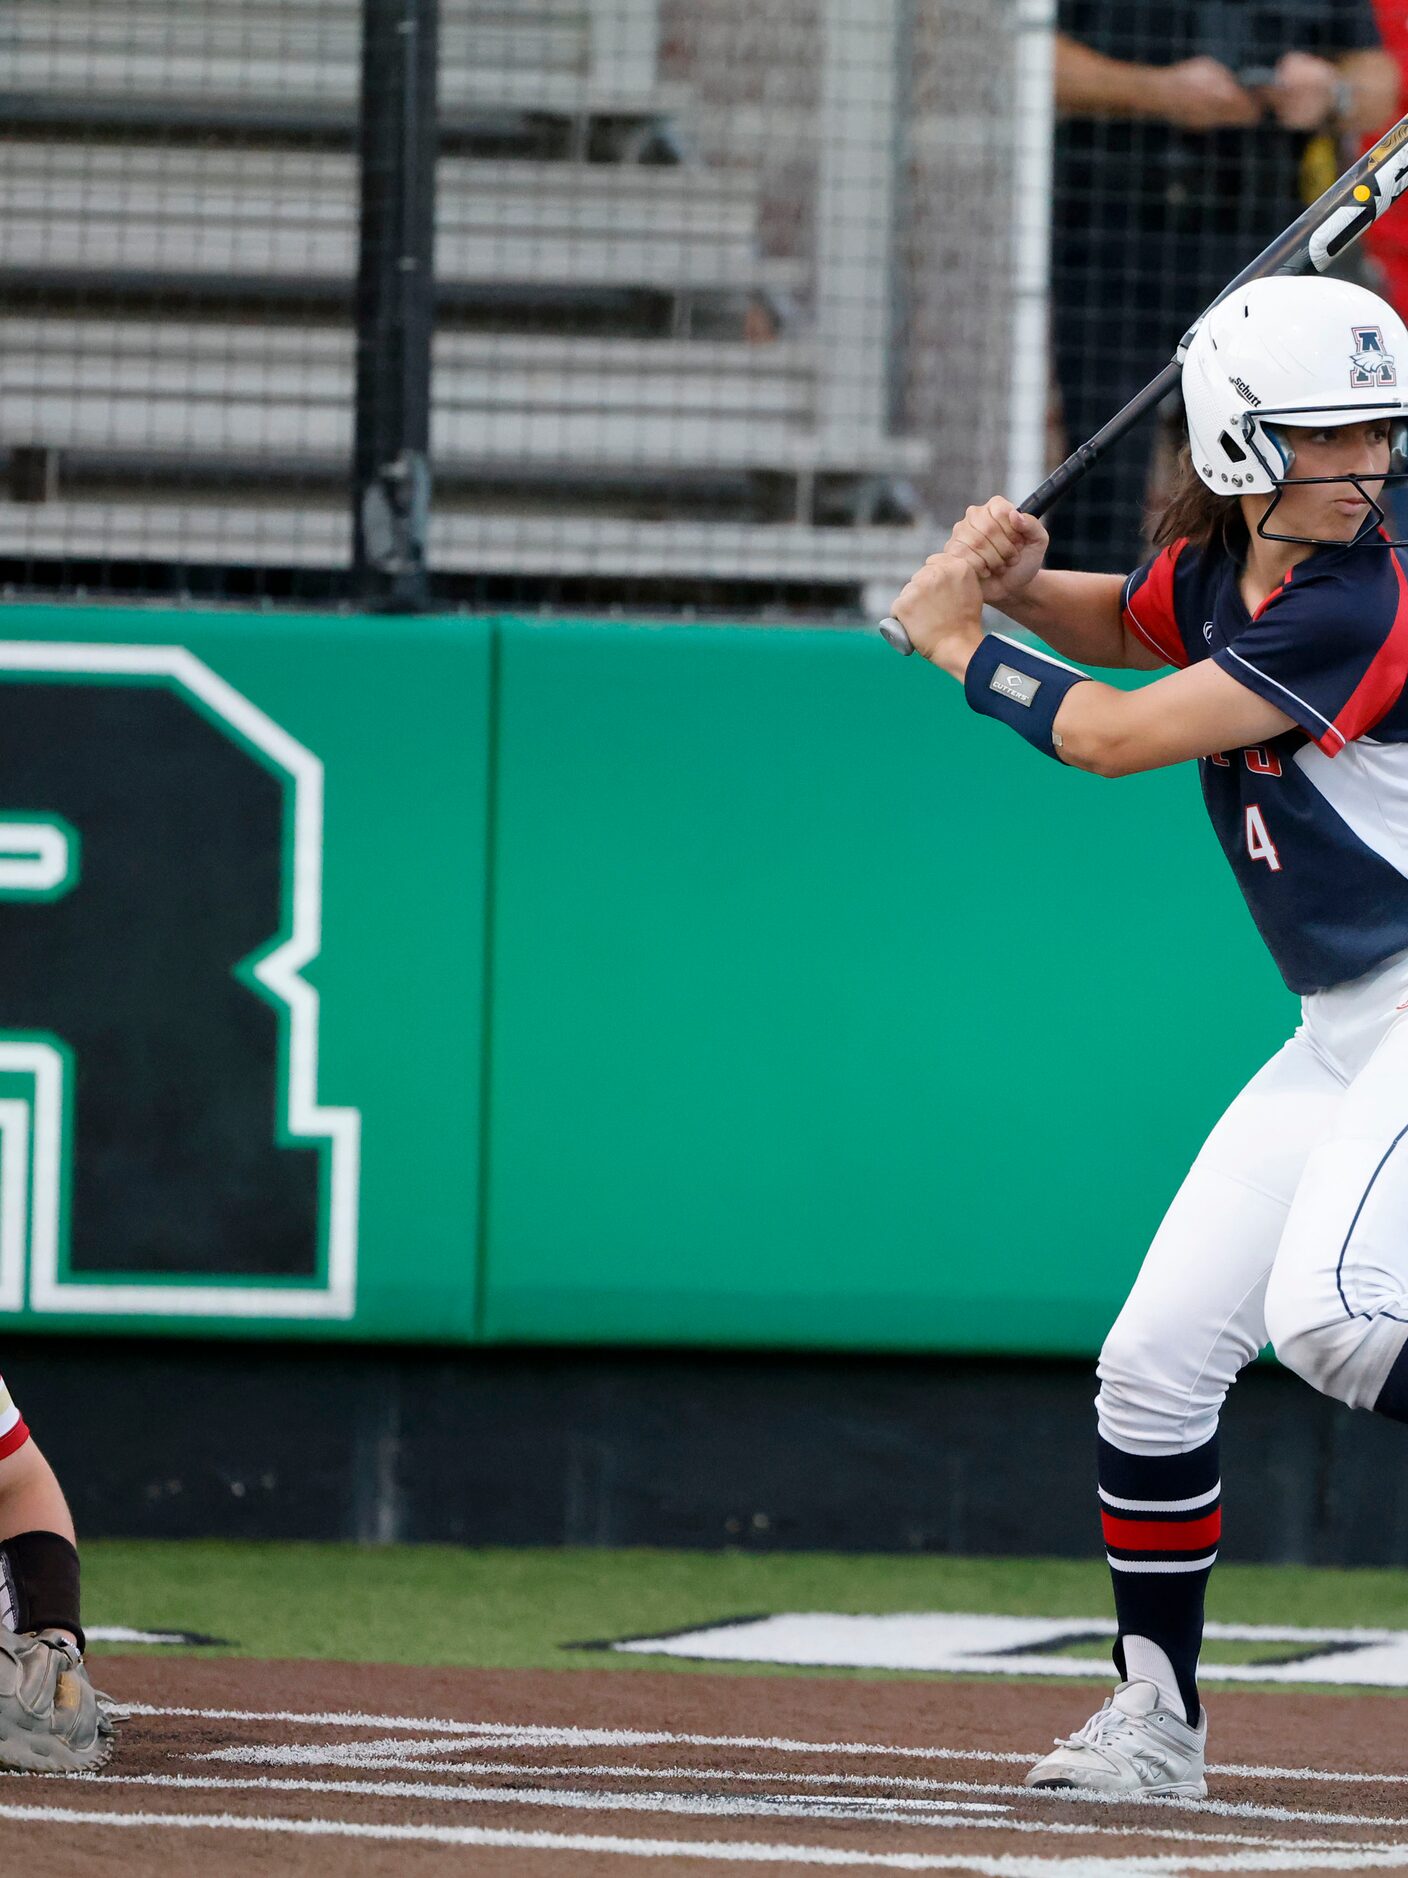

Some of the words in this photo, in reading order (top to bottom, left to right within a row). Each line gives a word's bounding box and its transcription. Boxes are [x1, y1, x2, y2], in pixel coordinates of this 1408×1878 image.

[1234, 377, 1262, 408] schutt
[992, 681, 1029, 701] CUTTERS
[1246, 803, 1282, 872] 4
